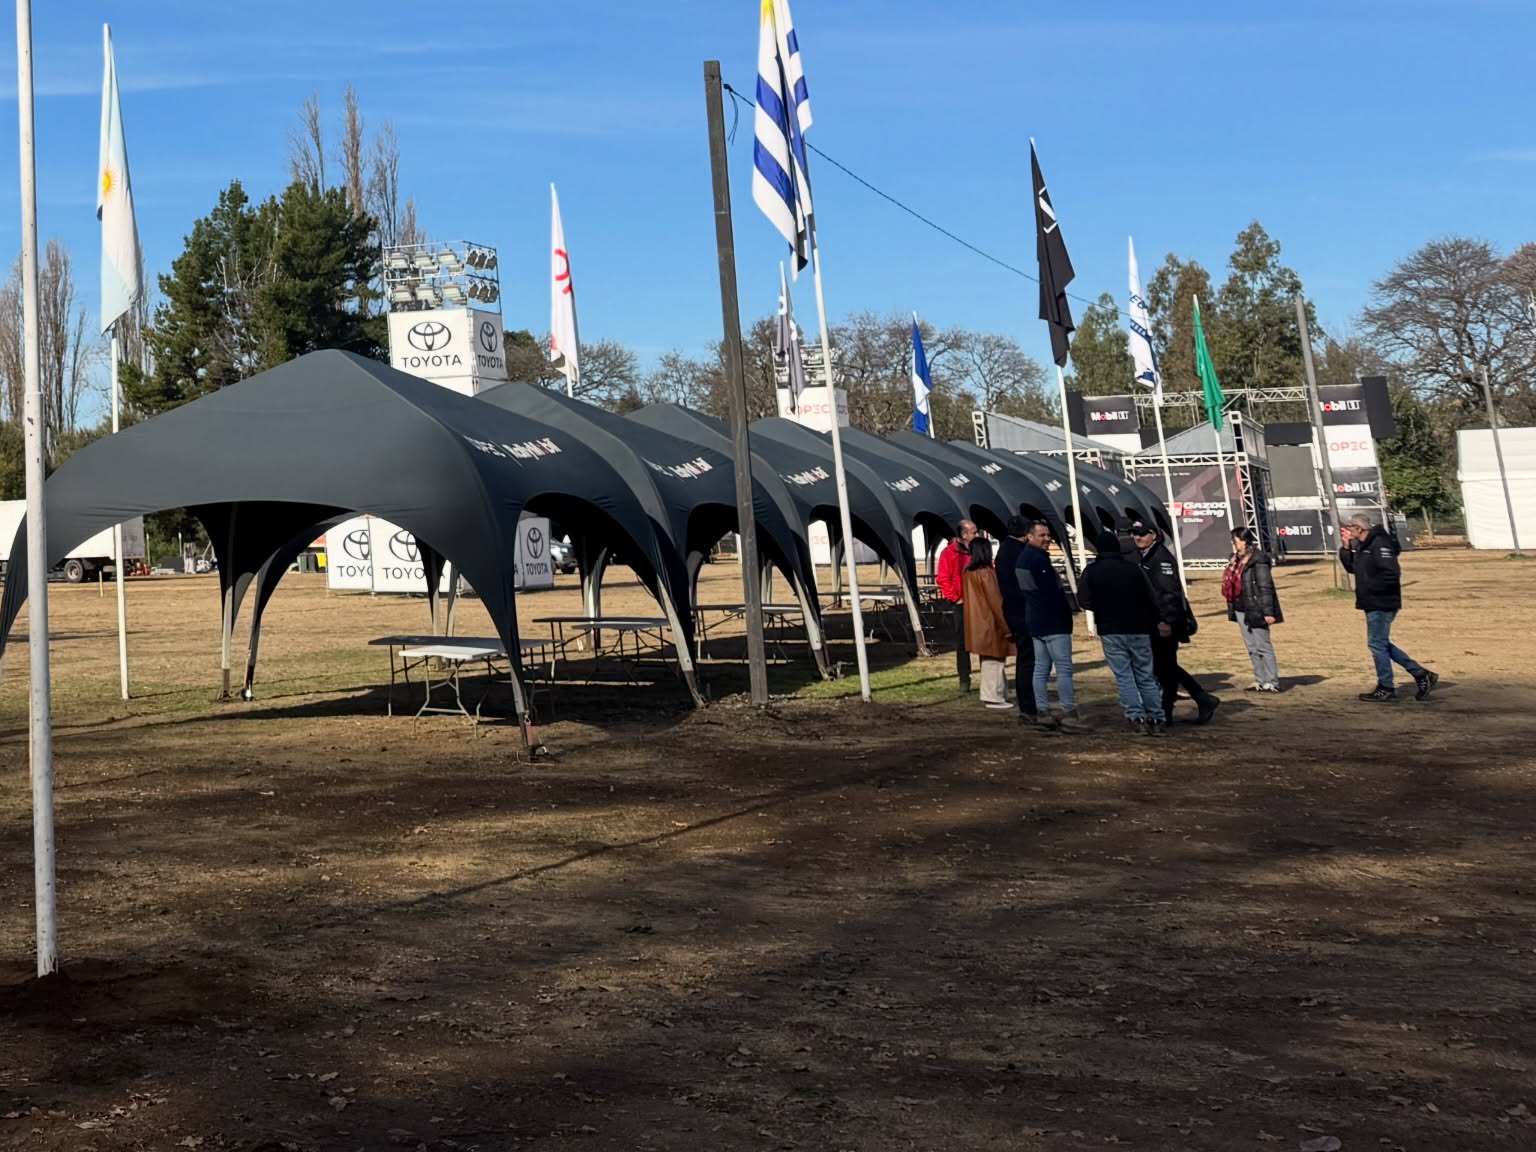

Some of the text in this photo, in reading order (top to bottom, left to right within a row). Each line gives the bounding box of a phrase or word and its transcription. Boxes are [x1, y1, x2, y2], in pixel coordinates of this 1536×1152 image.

[401, 354, 462, 368] TOYOTA
[477, 355, 504, 368] TOYOTA
[1329, 442, 1368, 451] OPEC
[382, 567, 425, 580] TOYO
[526, 563, 549, 576] TOYOTA
